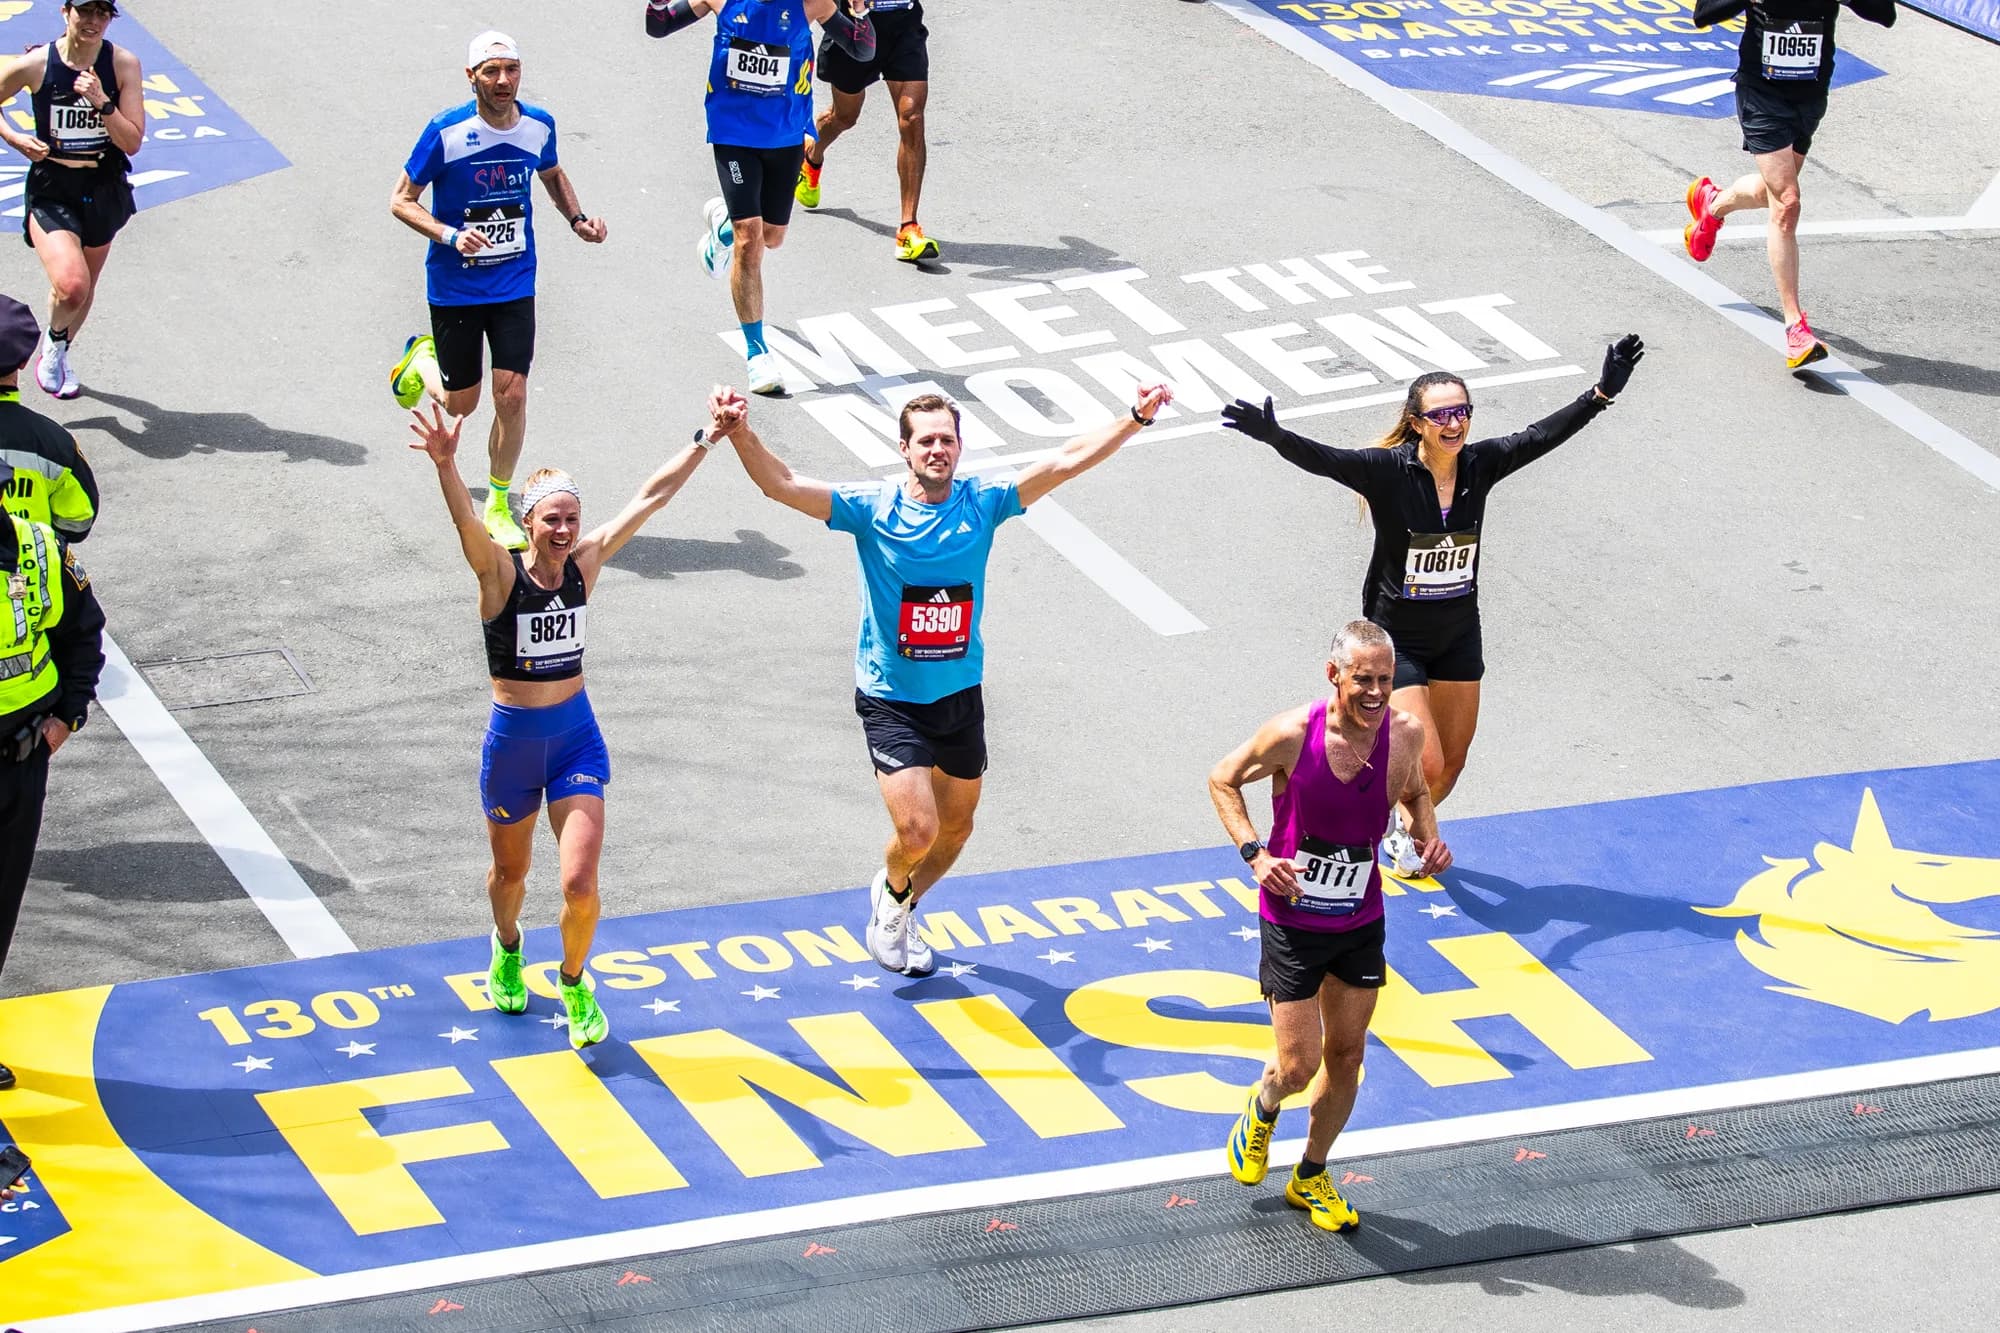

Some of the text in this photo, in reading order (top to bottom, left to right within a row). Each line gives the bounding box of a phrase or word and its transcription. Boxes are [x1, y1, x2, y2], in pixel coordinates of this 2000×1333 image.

[1360, 44, 1502, 59] BANK
[1510, 43, 1570, 54] OF
[1769, 35, 1817, 57] 10955
[737, 53, 779, 77] 8304
[717, 249, 1416, 393] MEET THE
[798, 293, 1561, 468] MOMENT
[1414, 547, 1470, 573] 10819
[531, 612, 576, 644] 9821
[911, 605, 962, 633] 5390
[1304, 857, 1359, 887] 9111
[199, 983, 415, 1046] 130TH
[254, 931, 1654, 1236] FINISH
